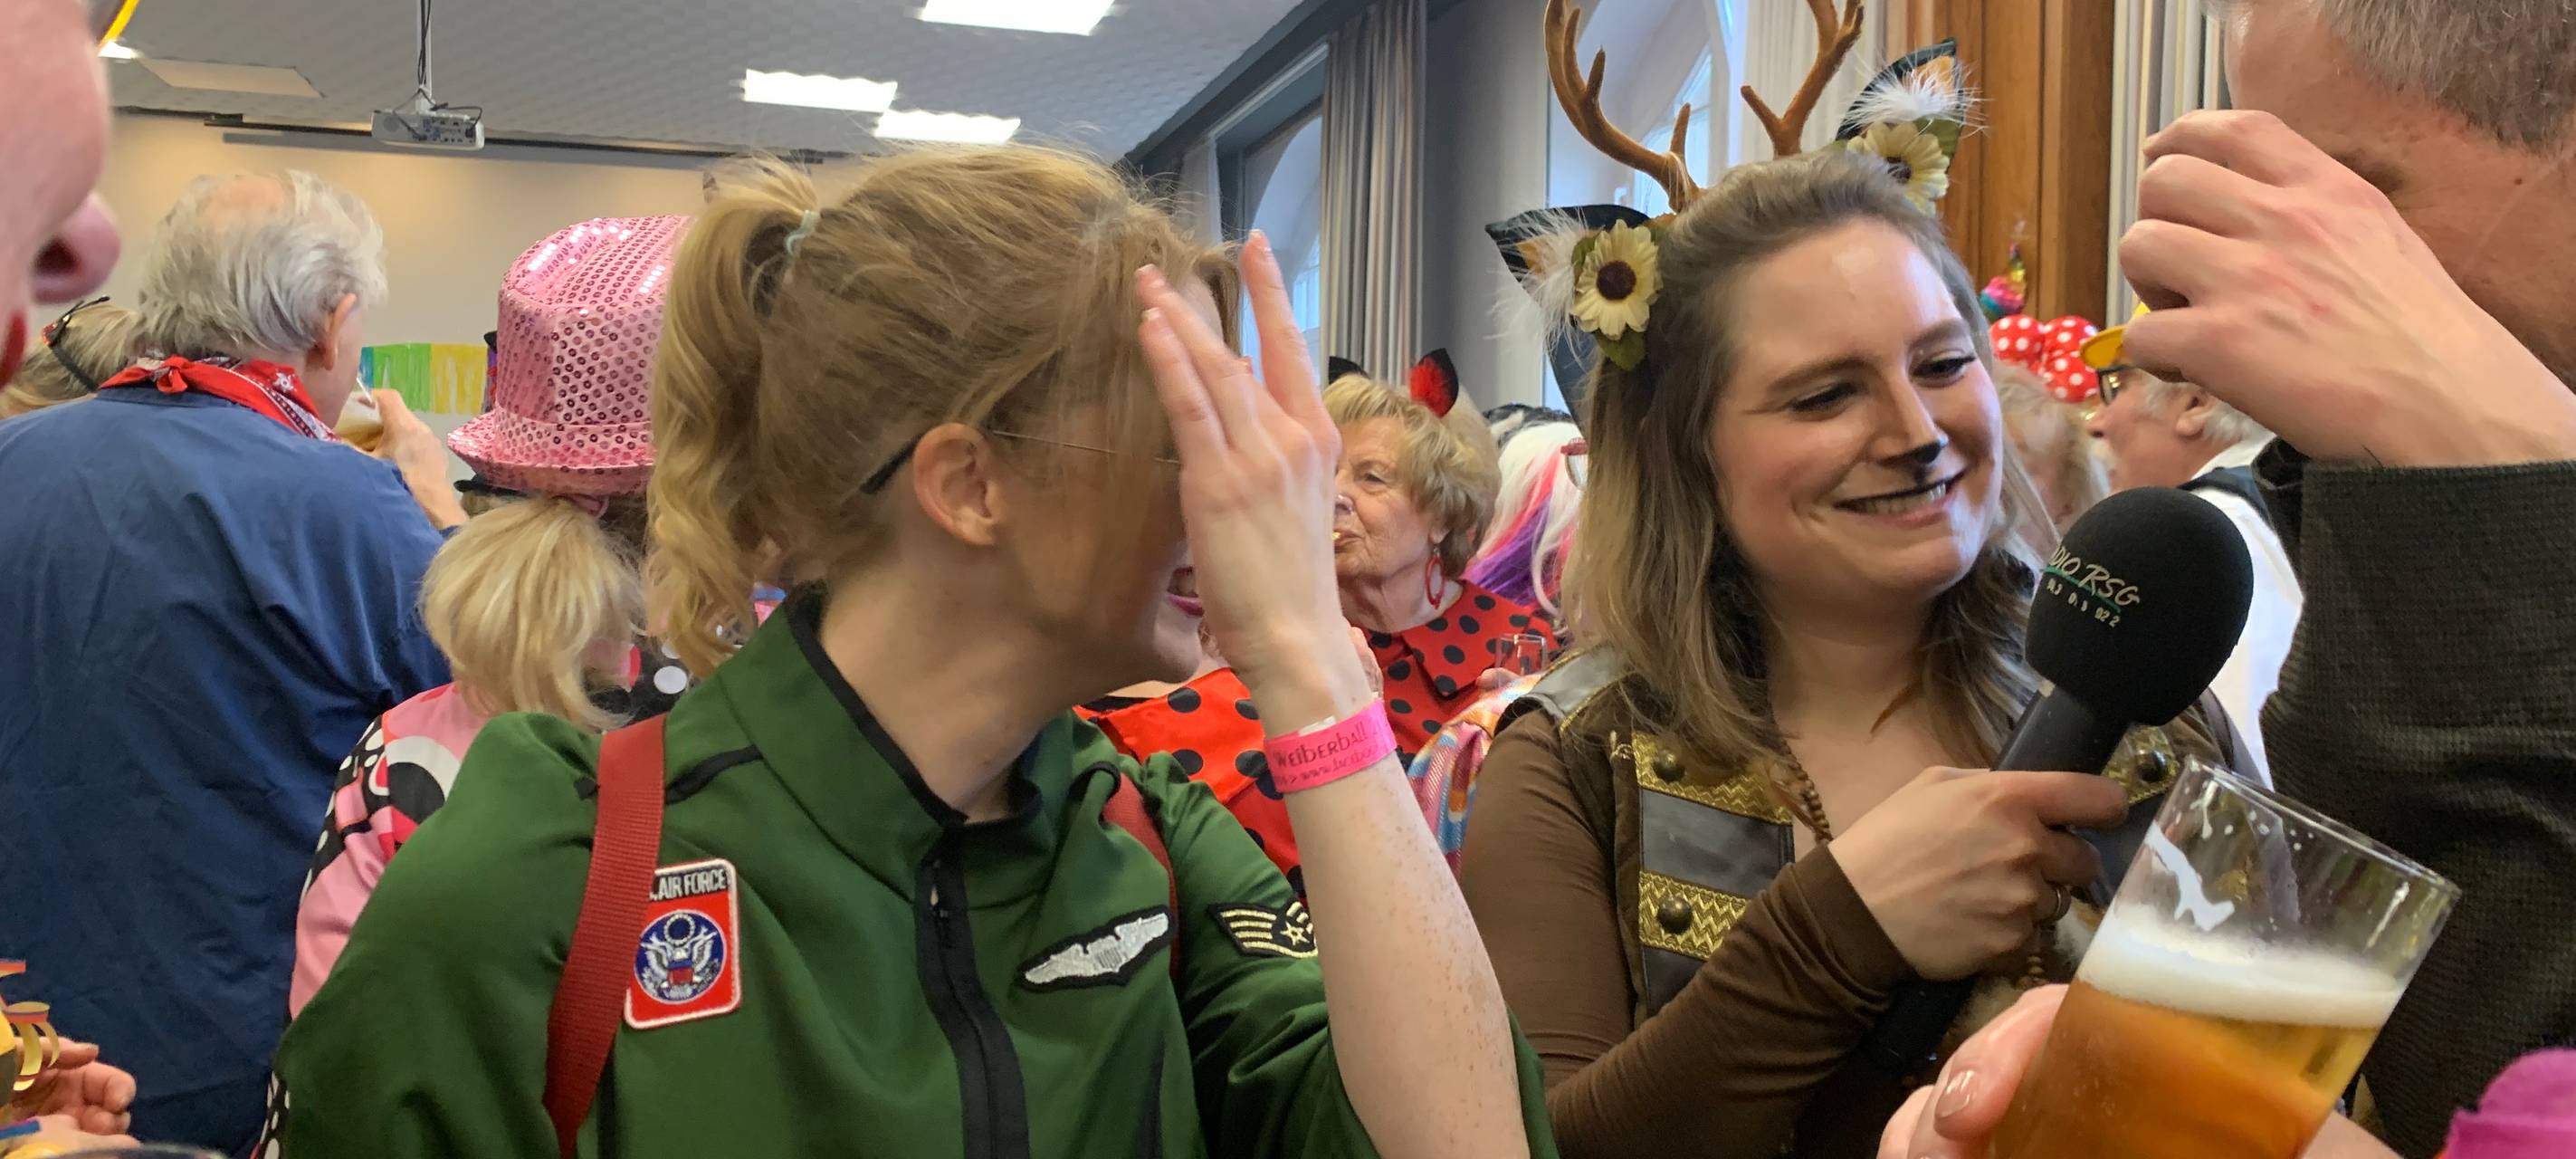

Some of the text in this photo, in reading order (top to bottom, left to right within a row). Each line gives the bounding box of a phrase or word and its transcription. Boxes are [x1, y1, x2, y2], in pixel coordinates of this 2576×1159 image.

[2048, 546, 2081, 575] DIO
[2079, 564, 2141, 606] RSG
[658, 868, 727, 901] AIR FORCE
